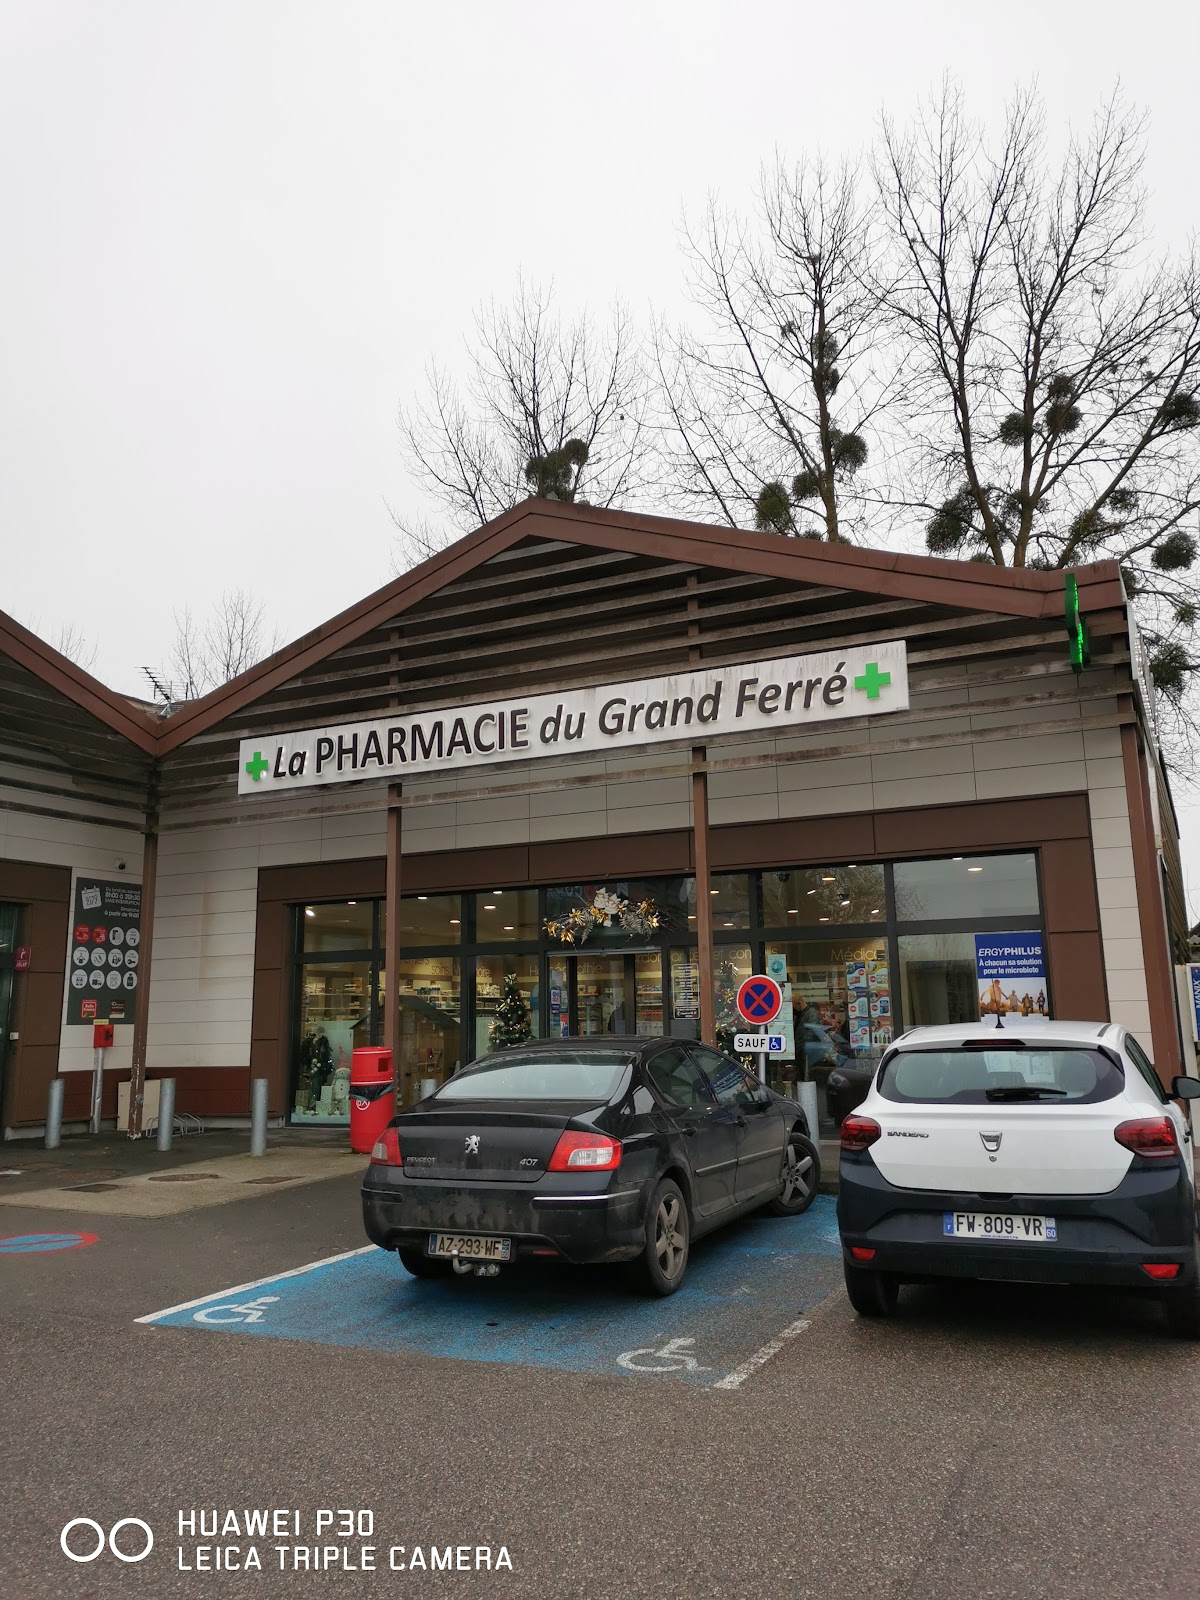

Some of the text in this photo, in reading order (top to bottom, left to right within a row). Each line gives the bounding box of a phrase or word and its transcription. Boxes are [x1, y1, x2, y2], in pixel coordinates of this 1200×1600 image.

[272, 661, 848, 779] La PHARMACIE du Grand Ferré
[124, 893, 141, 901] 20h30
[978, 946, 1042, 957] ERGYPHILUS
[979, 958, 984, 967] À
[984, 958, 1008, 967] chacun
[1016, 957, 1042, 966] solution
[431, 962, 450, 976] soins
[983, 968, 998, 976] pour
[1005, 966, 1039, 974] microbiote
[737, 1037, 767, 1048] SAUF
[887, 1131, 930, 1139] SANDERO
[519, 1158, 539, 1166] 407
[955, 1214, 1043, 1237] FW-809-VR
[1046, 1228, 1056, 1238] 60
[437, 1236, 502, 1257] AZ-293-WF
